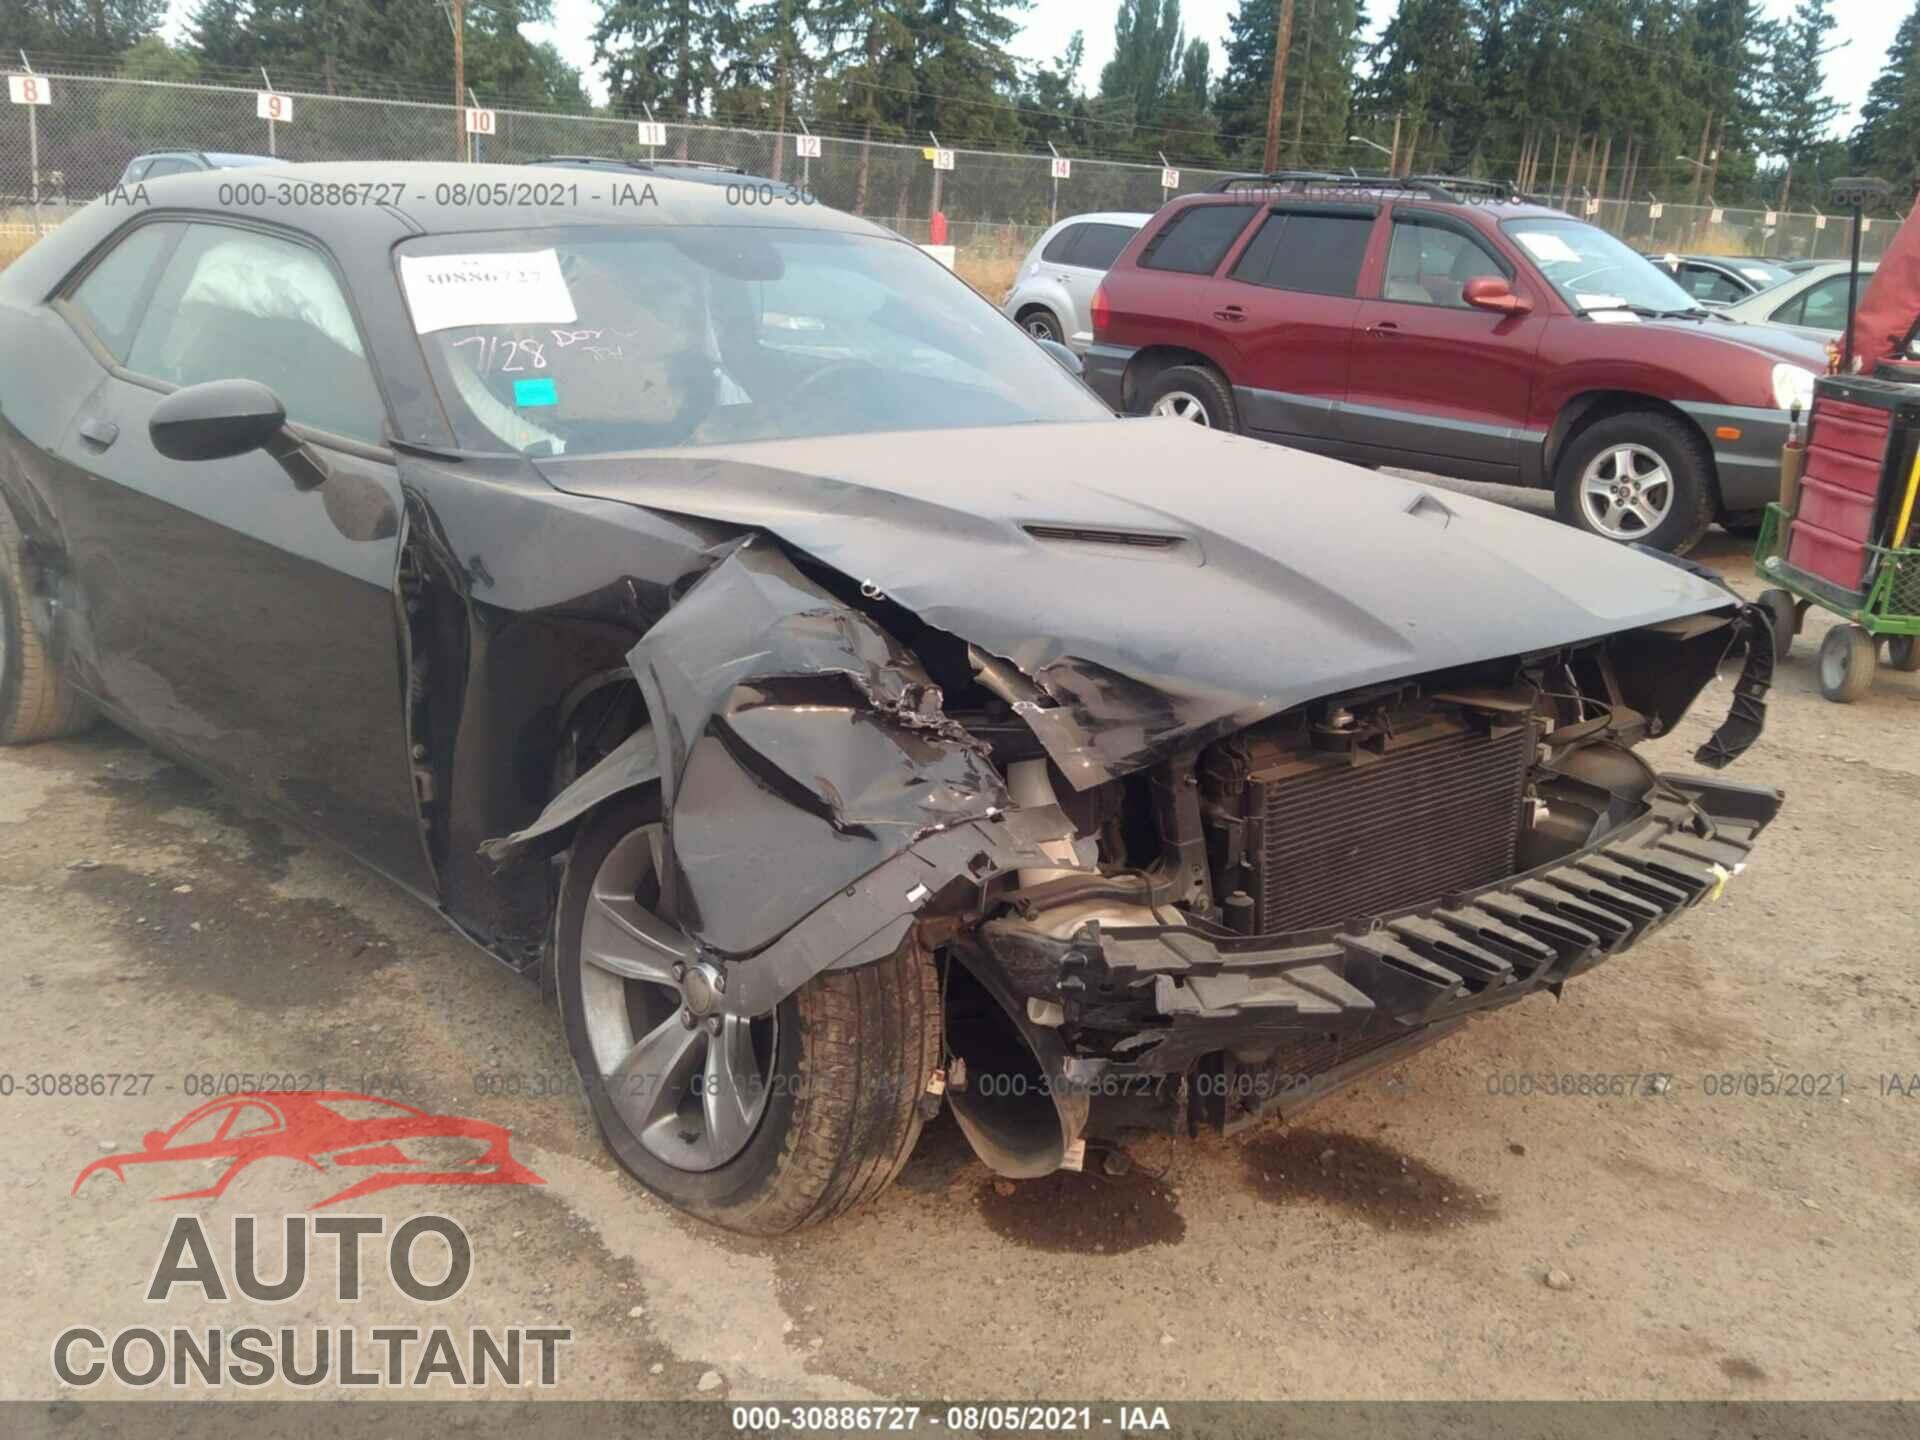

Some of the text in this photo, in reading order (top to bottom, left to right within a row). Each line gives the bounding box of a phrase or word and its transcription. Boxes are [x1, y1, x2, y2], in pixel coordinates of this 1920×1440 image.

[23, 78, 39, 102] 8
[268, 96, 282, 119] 9
[470, 111, 491, 133] 10
[644, 124, 660, 143] 11
[801, 138, 818, 156] 12
[936, 151, 951, 169] 13
[1055, 160, 1069, 176] 14
[1163, 170, 1177, 186] 15
[451, 336, 548, 373] 7128
